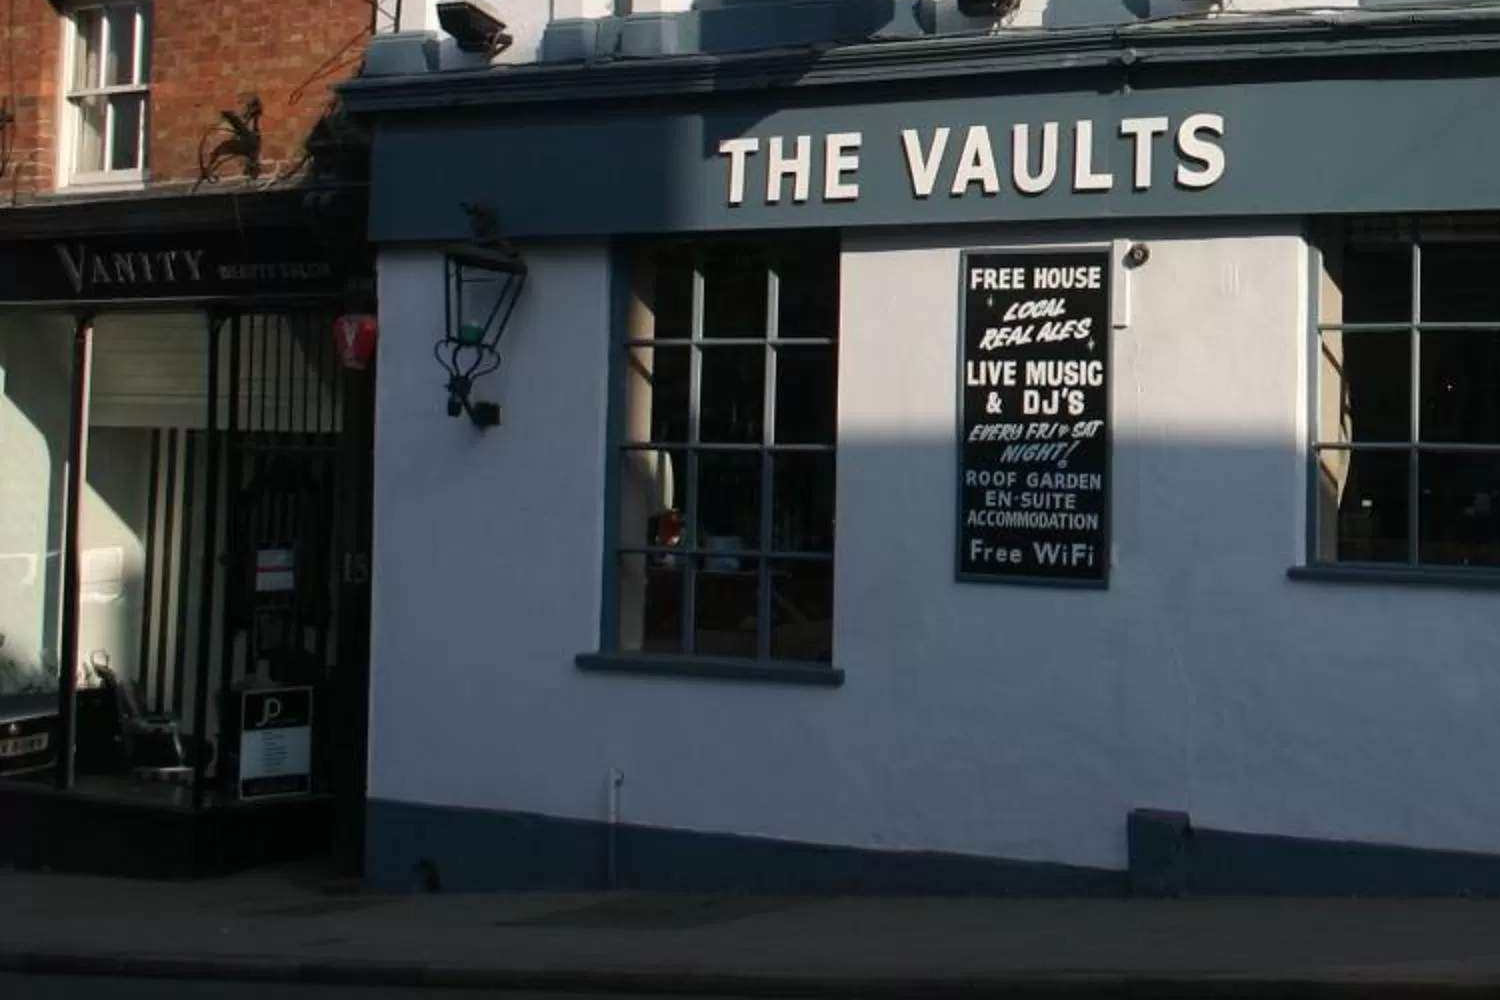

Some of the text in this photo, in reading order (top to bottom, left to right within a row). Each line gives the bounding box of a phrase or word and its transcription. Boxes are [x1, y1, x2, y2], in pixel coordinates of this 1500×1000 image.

[719, 113, 1226, 203] THE VAULTS
[970, 266, 1102, 290] FREE HOUSE
[1003, 298, 1066, 322] LOCAL
[978, 317, 1092, 350] REAL ALES
[967, 360, 1104, 387] LIVE MUSIC
[985, 387, 1085, 416] & DJ'S
[968, 423, 1023, 442] EVERY
[1025, 422, 1058, 440] FRI
[1071, 420, 1104, 438] SAT
[1000, 440, 1080, 469] NIGHT!
[965, 469, 1102, 490] ROOF GARDEN
[967, 509, 1098, 530] ACCOMMODATION
[970, 538, 1094, 567] Free WiFi
